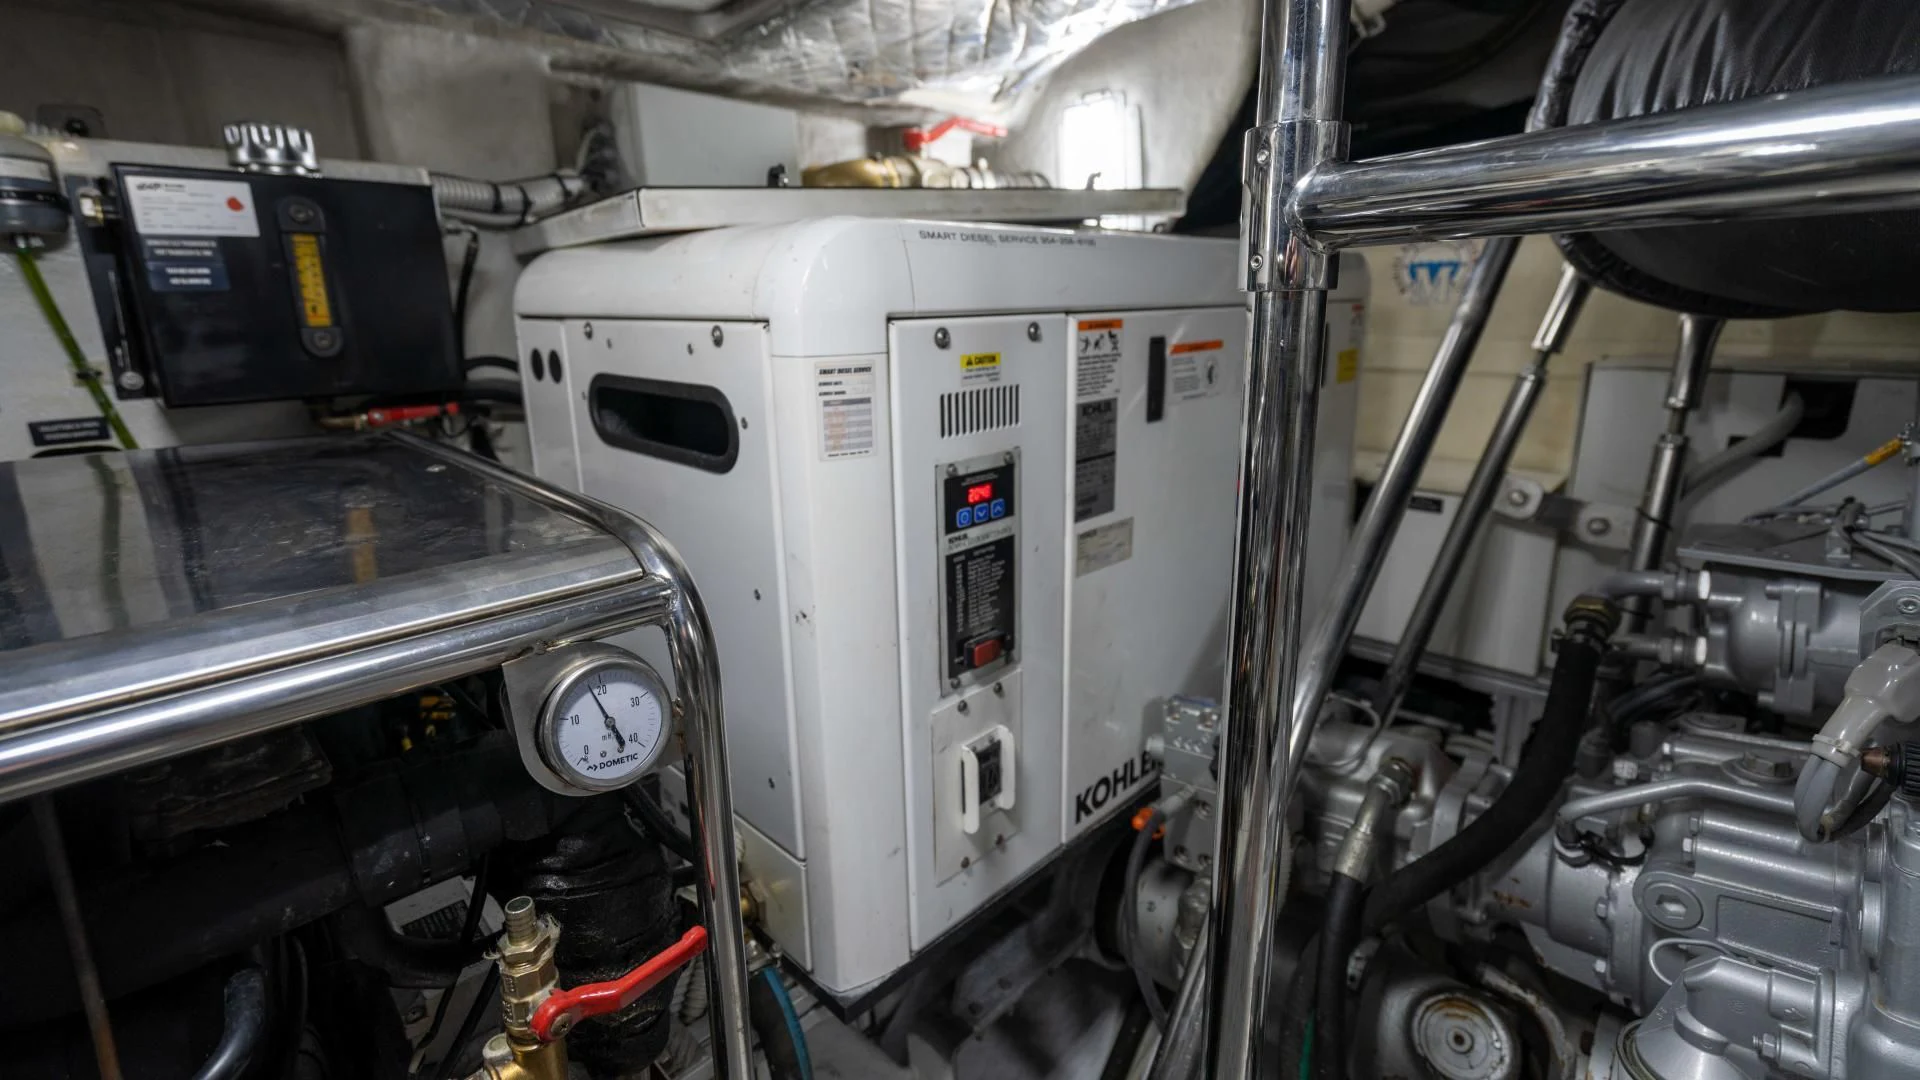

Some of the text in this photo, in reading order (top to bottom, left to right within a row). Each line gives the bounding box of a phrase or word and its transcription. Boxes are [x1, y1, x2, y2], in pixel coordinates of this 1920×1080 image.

[919, 230, 956, 241] SMART
[960, 232, 995, 243] DIESEL
[999, 234, 1039, 245] SERVICE
[597, 684, 607, 696] 20
[630, 696, 640, 707] 30
[570, 714, 580, 725] 10
[628, 732, 639, 744] 40
[583, 744, 589, 755] 0
[599, 753, 639, 770] DOMETIC
